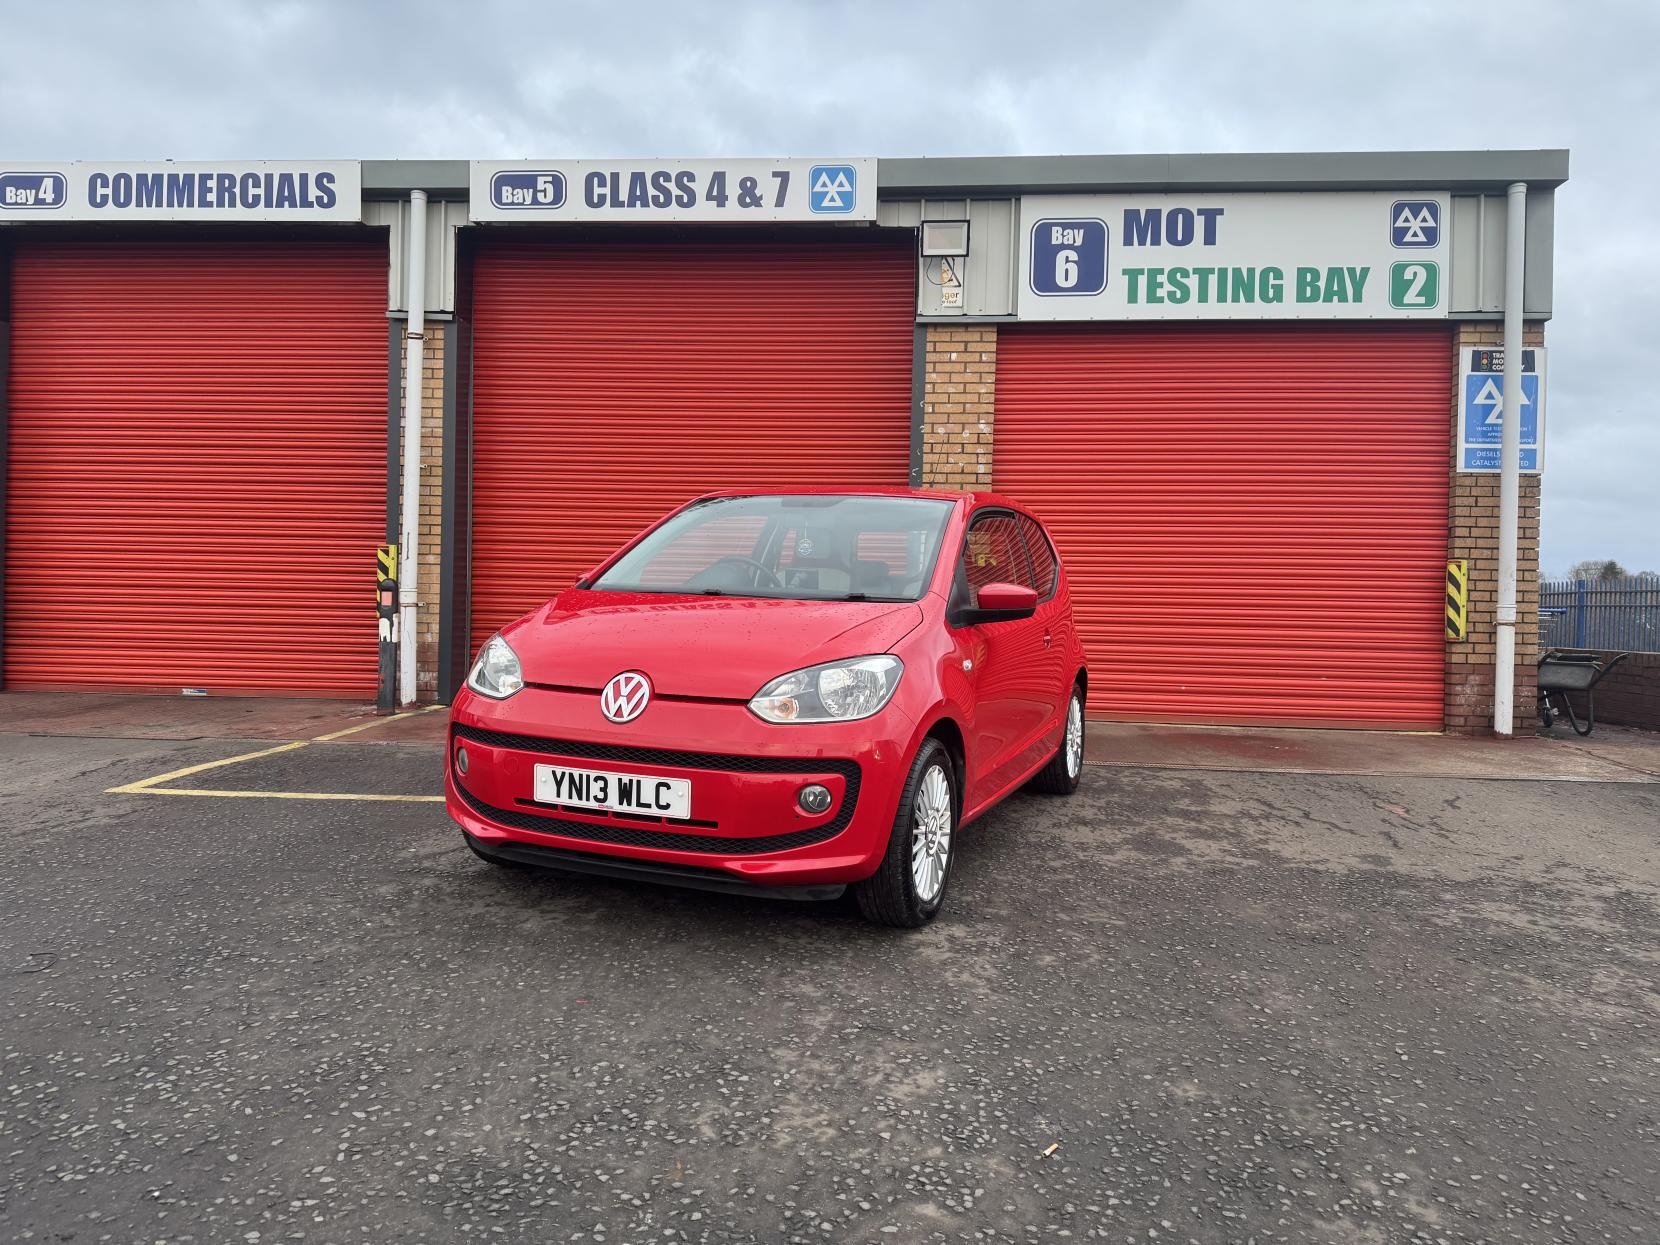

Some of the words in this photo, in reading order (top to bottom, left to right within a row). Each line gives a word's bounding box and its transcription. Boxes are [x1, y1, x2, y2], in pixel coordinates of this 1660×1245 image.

[5, 187, 36, 205] Bay
[38, 177, 55, 203] 4
[88, 172, 337, 209] COMMERCIALS
[501, 186, 533, 205] Bay
[535, 176, 554, 204] 5
[584, 171, 697, 209] CLASS
[705, 171, 729, 208] 4
[737, 176, 764, 209] &
[771, 171, 791, 208] 7
[1051, 226, 1084, 246] Bay
[1122, 208, 1225, 247] MOT
[1055, 249, 1079, 288] 6
[1121, 267, 1284, 304] TESTING
[1295, 267, 1371, 303] BAY
[1403, 265, 1428, 304] 2
[551, 769, 609, 804] YN13
[617, 777, 672, 811] WLC
